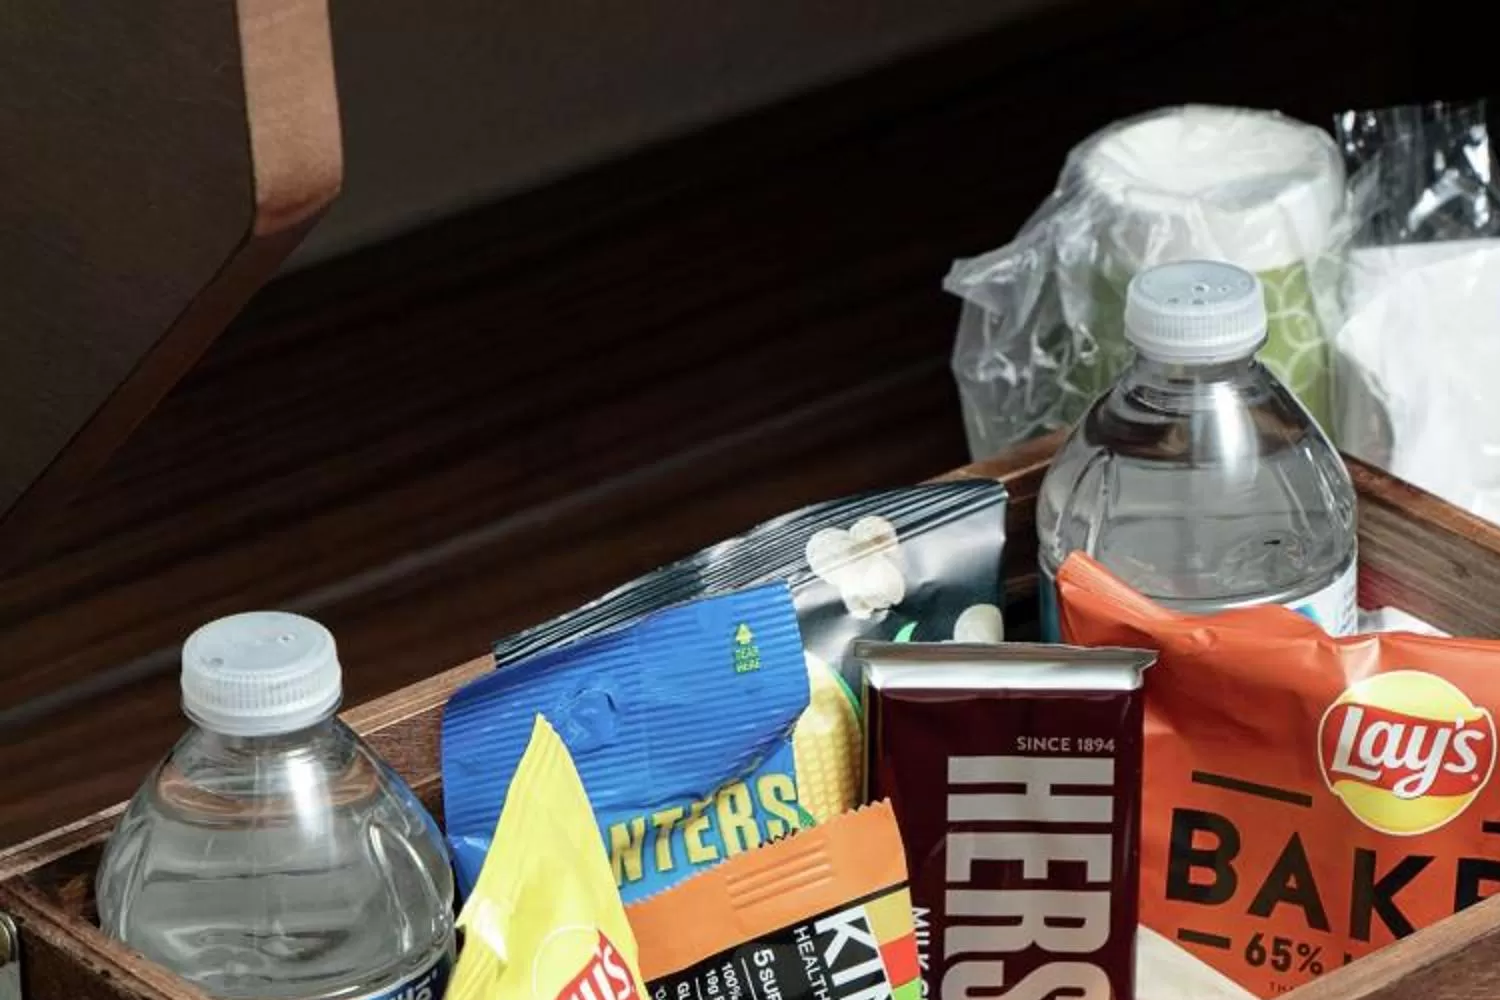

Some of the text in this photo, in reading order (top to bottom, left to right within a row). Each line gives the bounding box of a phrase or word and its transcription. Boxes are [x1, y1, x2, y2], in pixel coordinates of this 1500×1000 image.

[1016, 735, 1116, 752] SINCE 1894
[1330, 705, 1486, 800] Lay's
[753, 947, 775, 970] 5
[1244, 932, 1325, 976] 65%
[720, 962, 744, 1000] 100%
